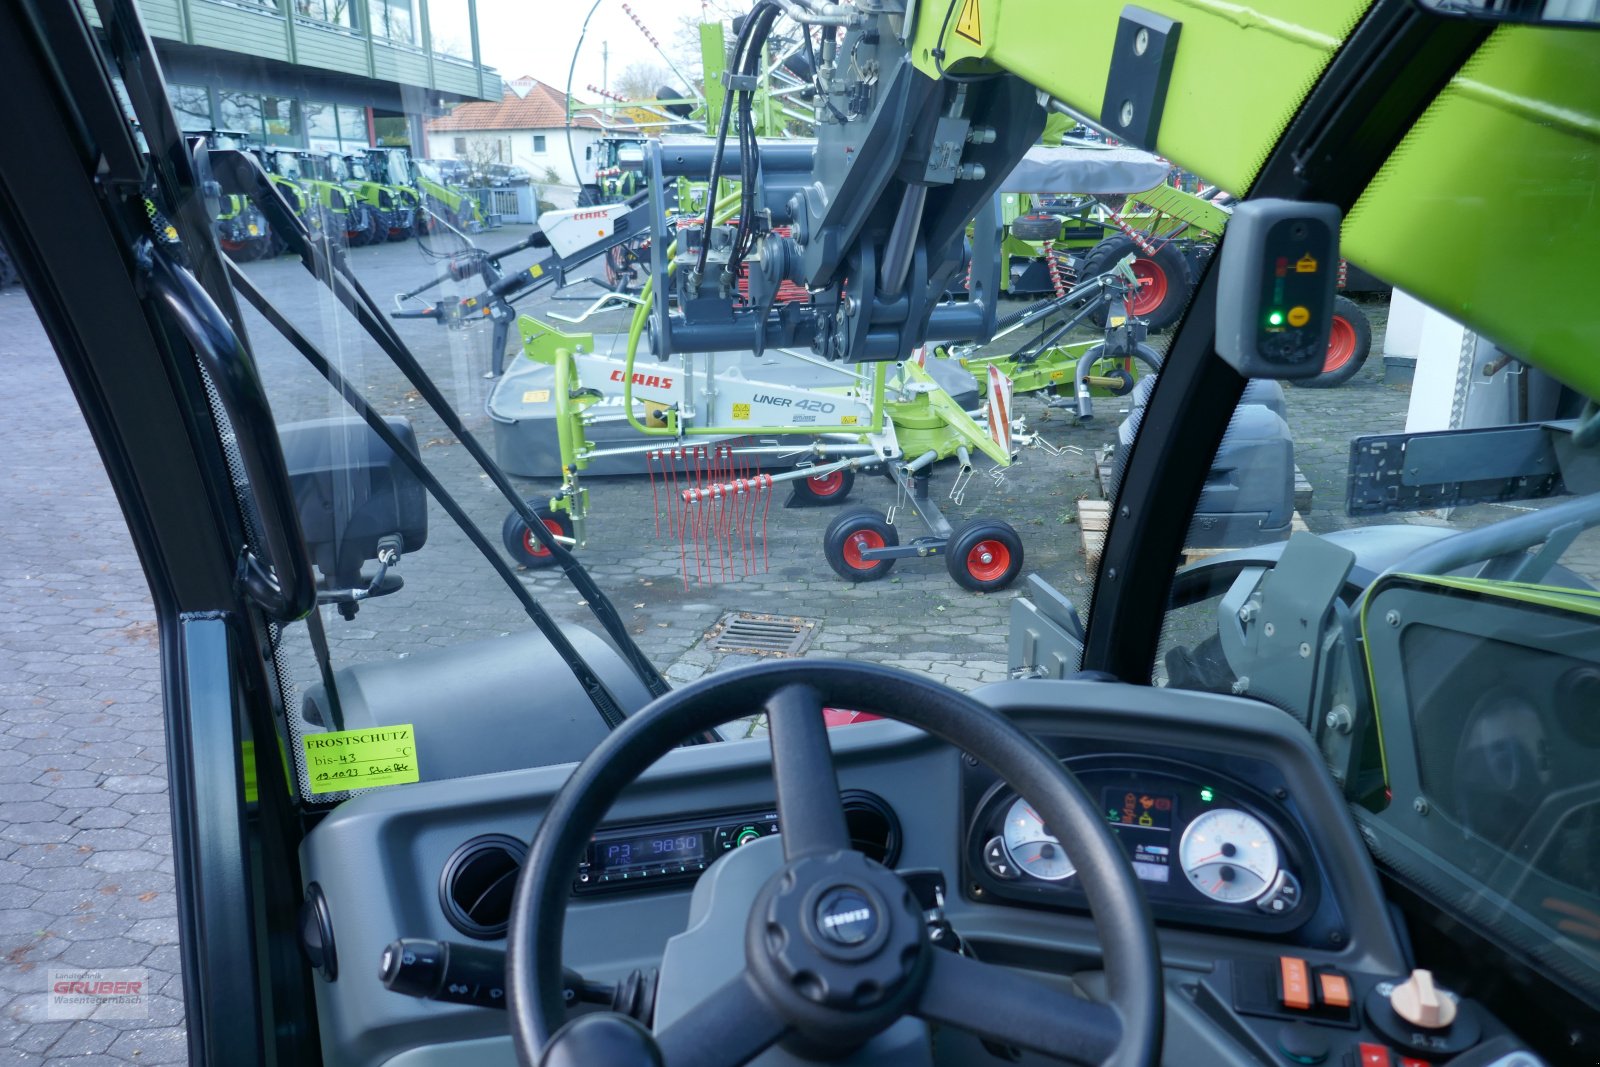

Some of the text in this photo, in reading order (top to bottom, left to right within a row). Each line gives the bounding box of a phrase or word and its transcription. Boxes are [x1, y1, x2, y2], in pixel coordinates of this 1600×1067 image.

[574, 210, 608, 221] CLAAS
[753, 394, 835, 414] LINER 420
[307, 731, 409, 749] FROSTSCHUTZ
